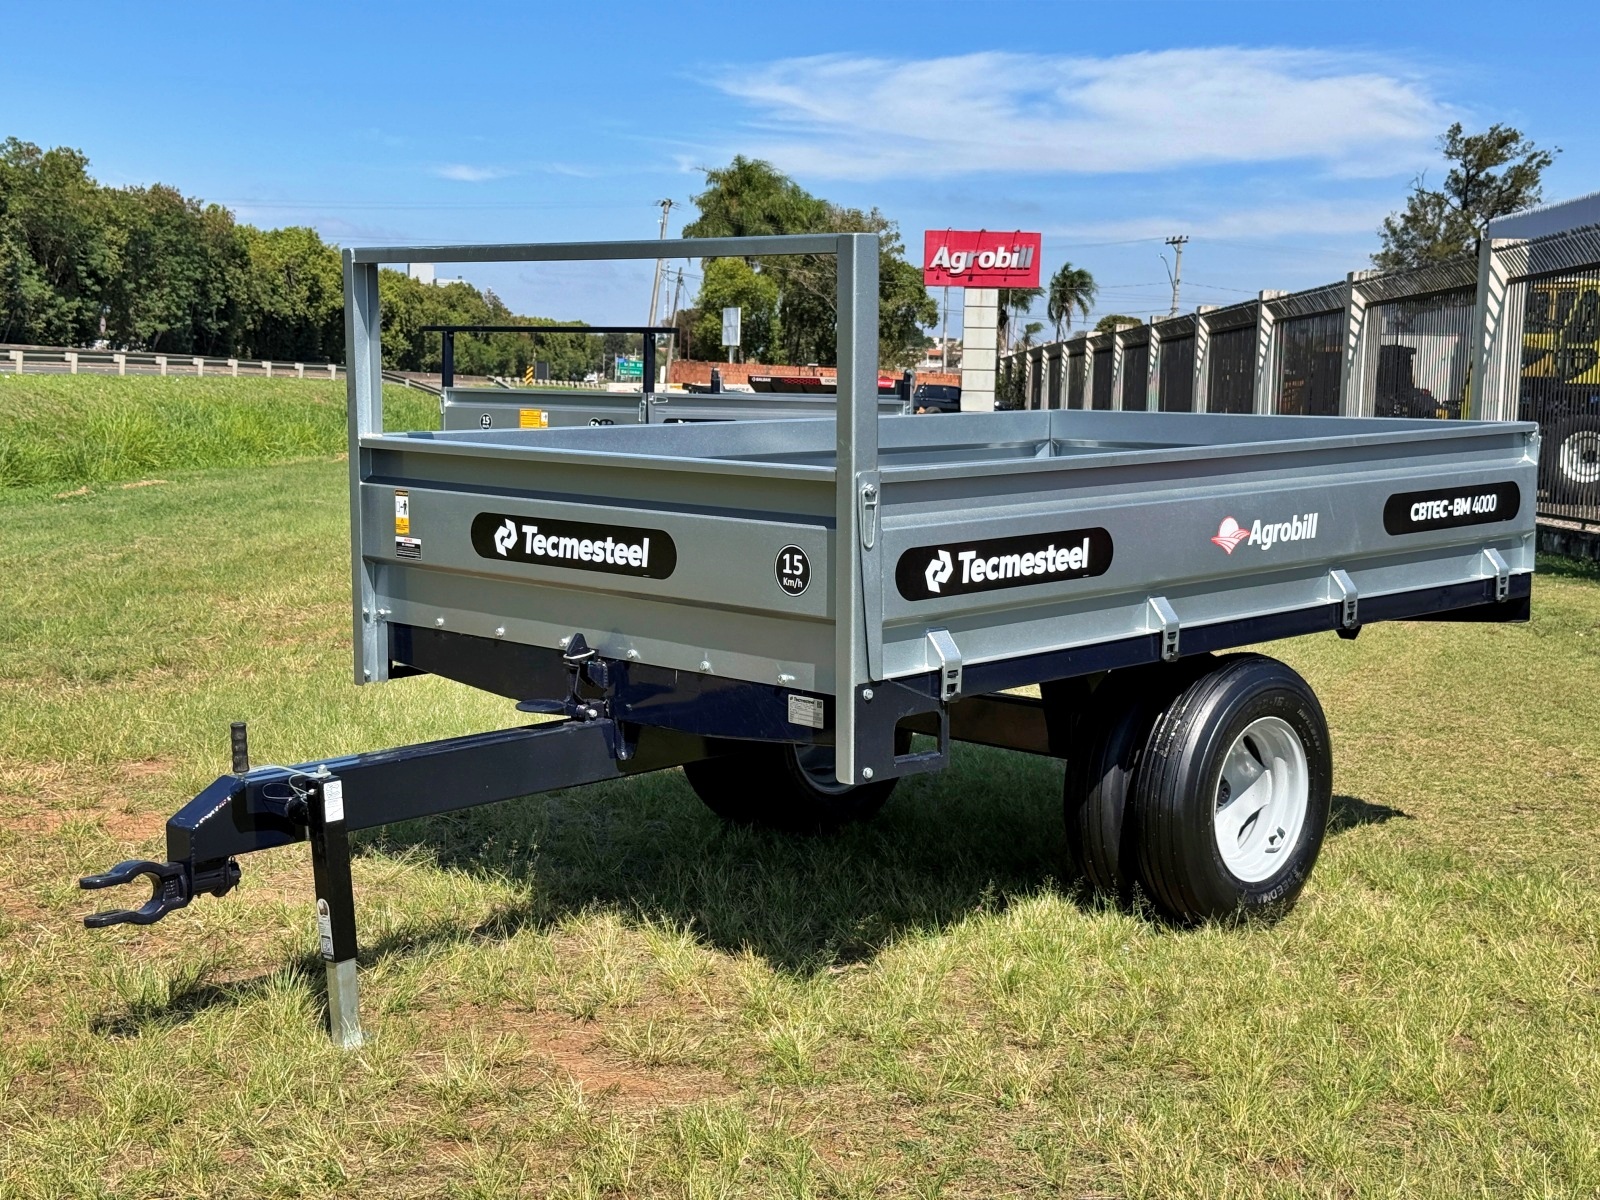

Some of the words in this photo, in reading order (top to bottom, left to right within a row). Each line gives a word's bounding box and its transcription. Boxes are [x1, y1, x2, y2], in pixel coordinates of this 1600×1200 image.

[928, 245, 1035, 274] Agrobill
[482, 416, 490, 424] 15
[1410, 496, 1472, 521] CBTEC-BM
[1472, 494, 1497, 514] 4000
[1247, 512, 1319, 551] Agrobill
[521, 524, 650, 568] Tecmesteel
[782, 553, 804, 576] 15
[958, 537, 1090, 584] Tecmesteel
[783, 577, 803, 589] Km/h
